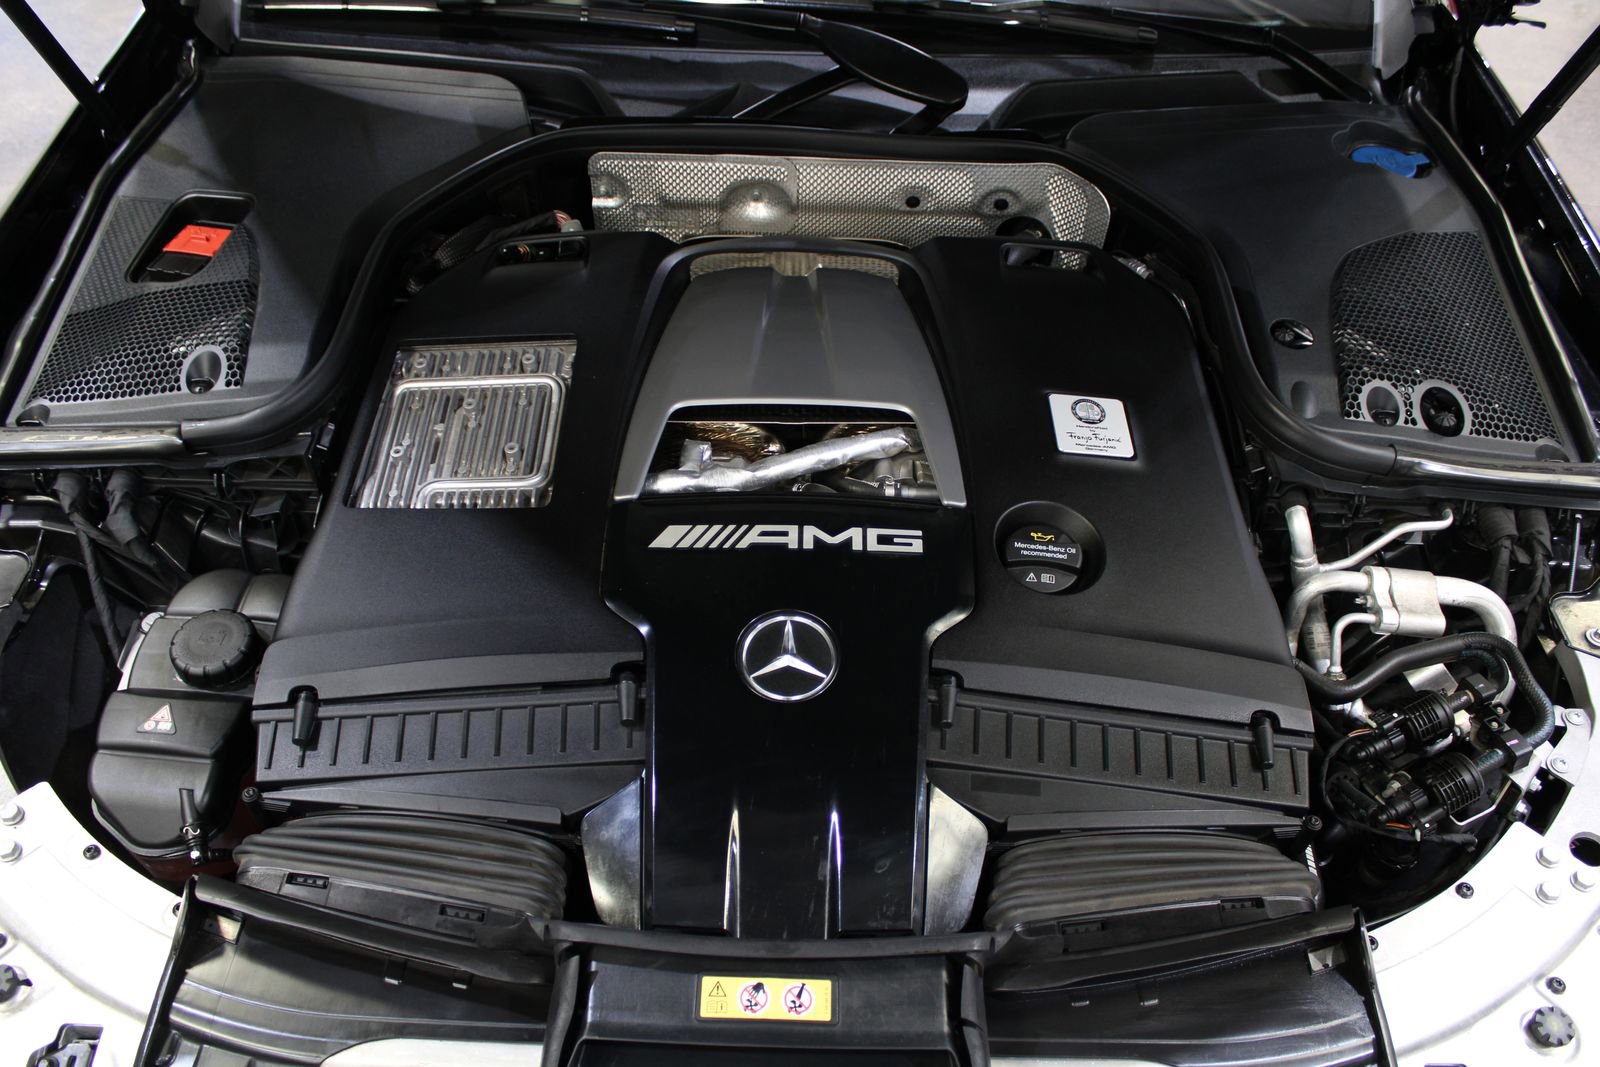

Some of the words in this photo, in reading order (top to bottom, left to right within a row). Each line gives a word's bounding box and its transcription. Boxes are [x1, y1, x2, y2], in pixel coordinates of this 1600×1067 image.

[734, 524, 924, 553] AMG
[1014, 541, 1066, 553] Mercedes-Benz
[1020, 550, 1068, 560] recommended
